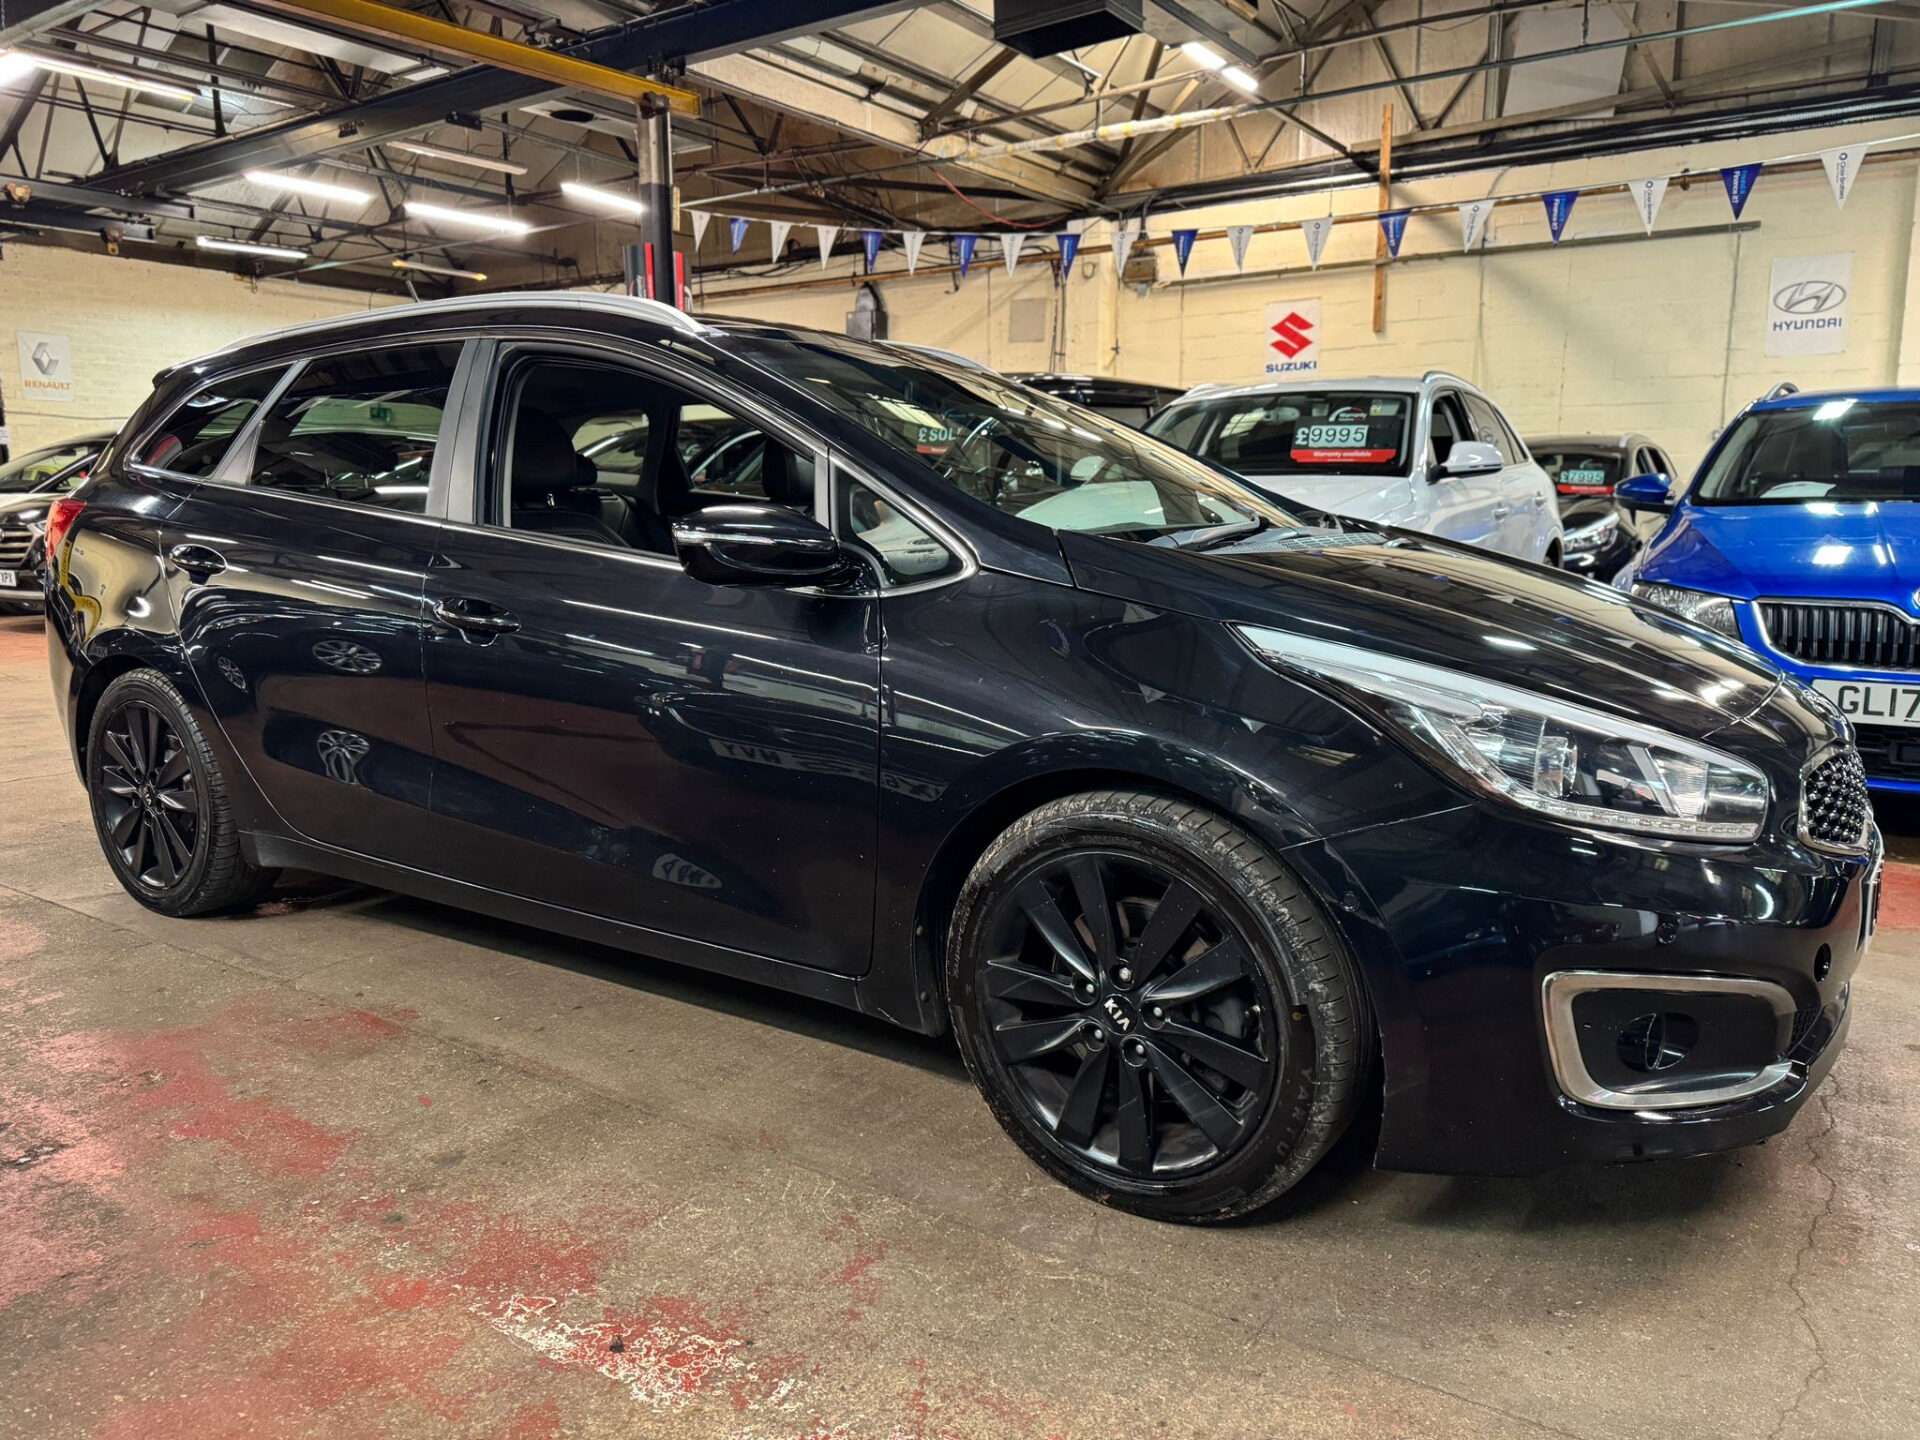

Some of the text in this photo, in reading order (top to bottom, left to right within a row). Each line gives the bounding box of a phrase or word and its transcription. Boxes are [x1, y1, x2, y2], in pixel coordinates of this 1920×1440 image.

[1772, 317, 1842, 332] HYUNDAI
[1265, 360, 1317, 373] SUZUKI
[24, 379, 71, 391] RENAULT
[918, 427, 958, 442] £SOL
[1295, 426, 1366, 446] £9995
[1838, 685, 1920, 719] GL17
[1104, 997, 1130, 1031] KIA
